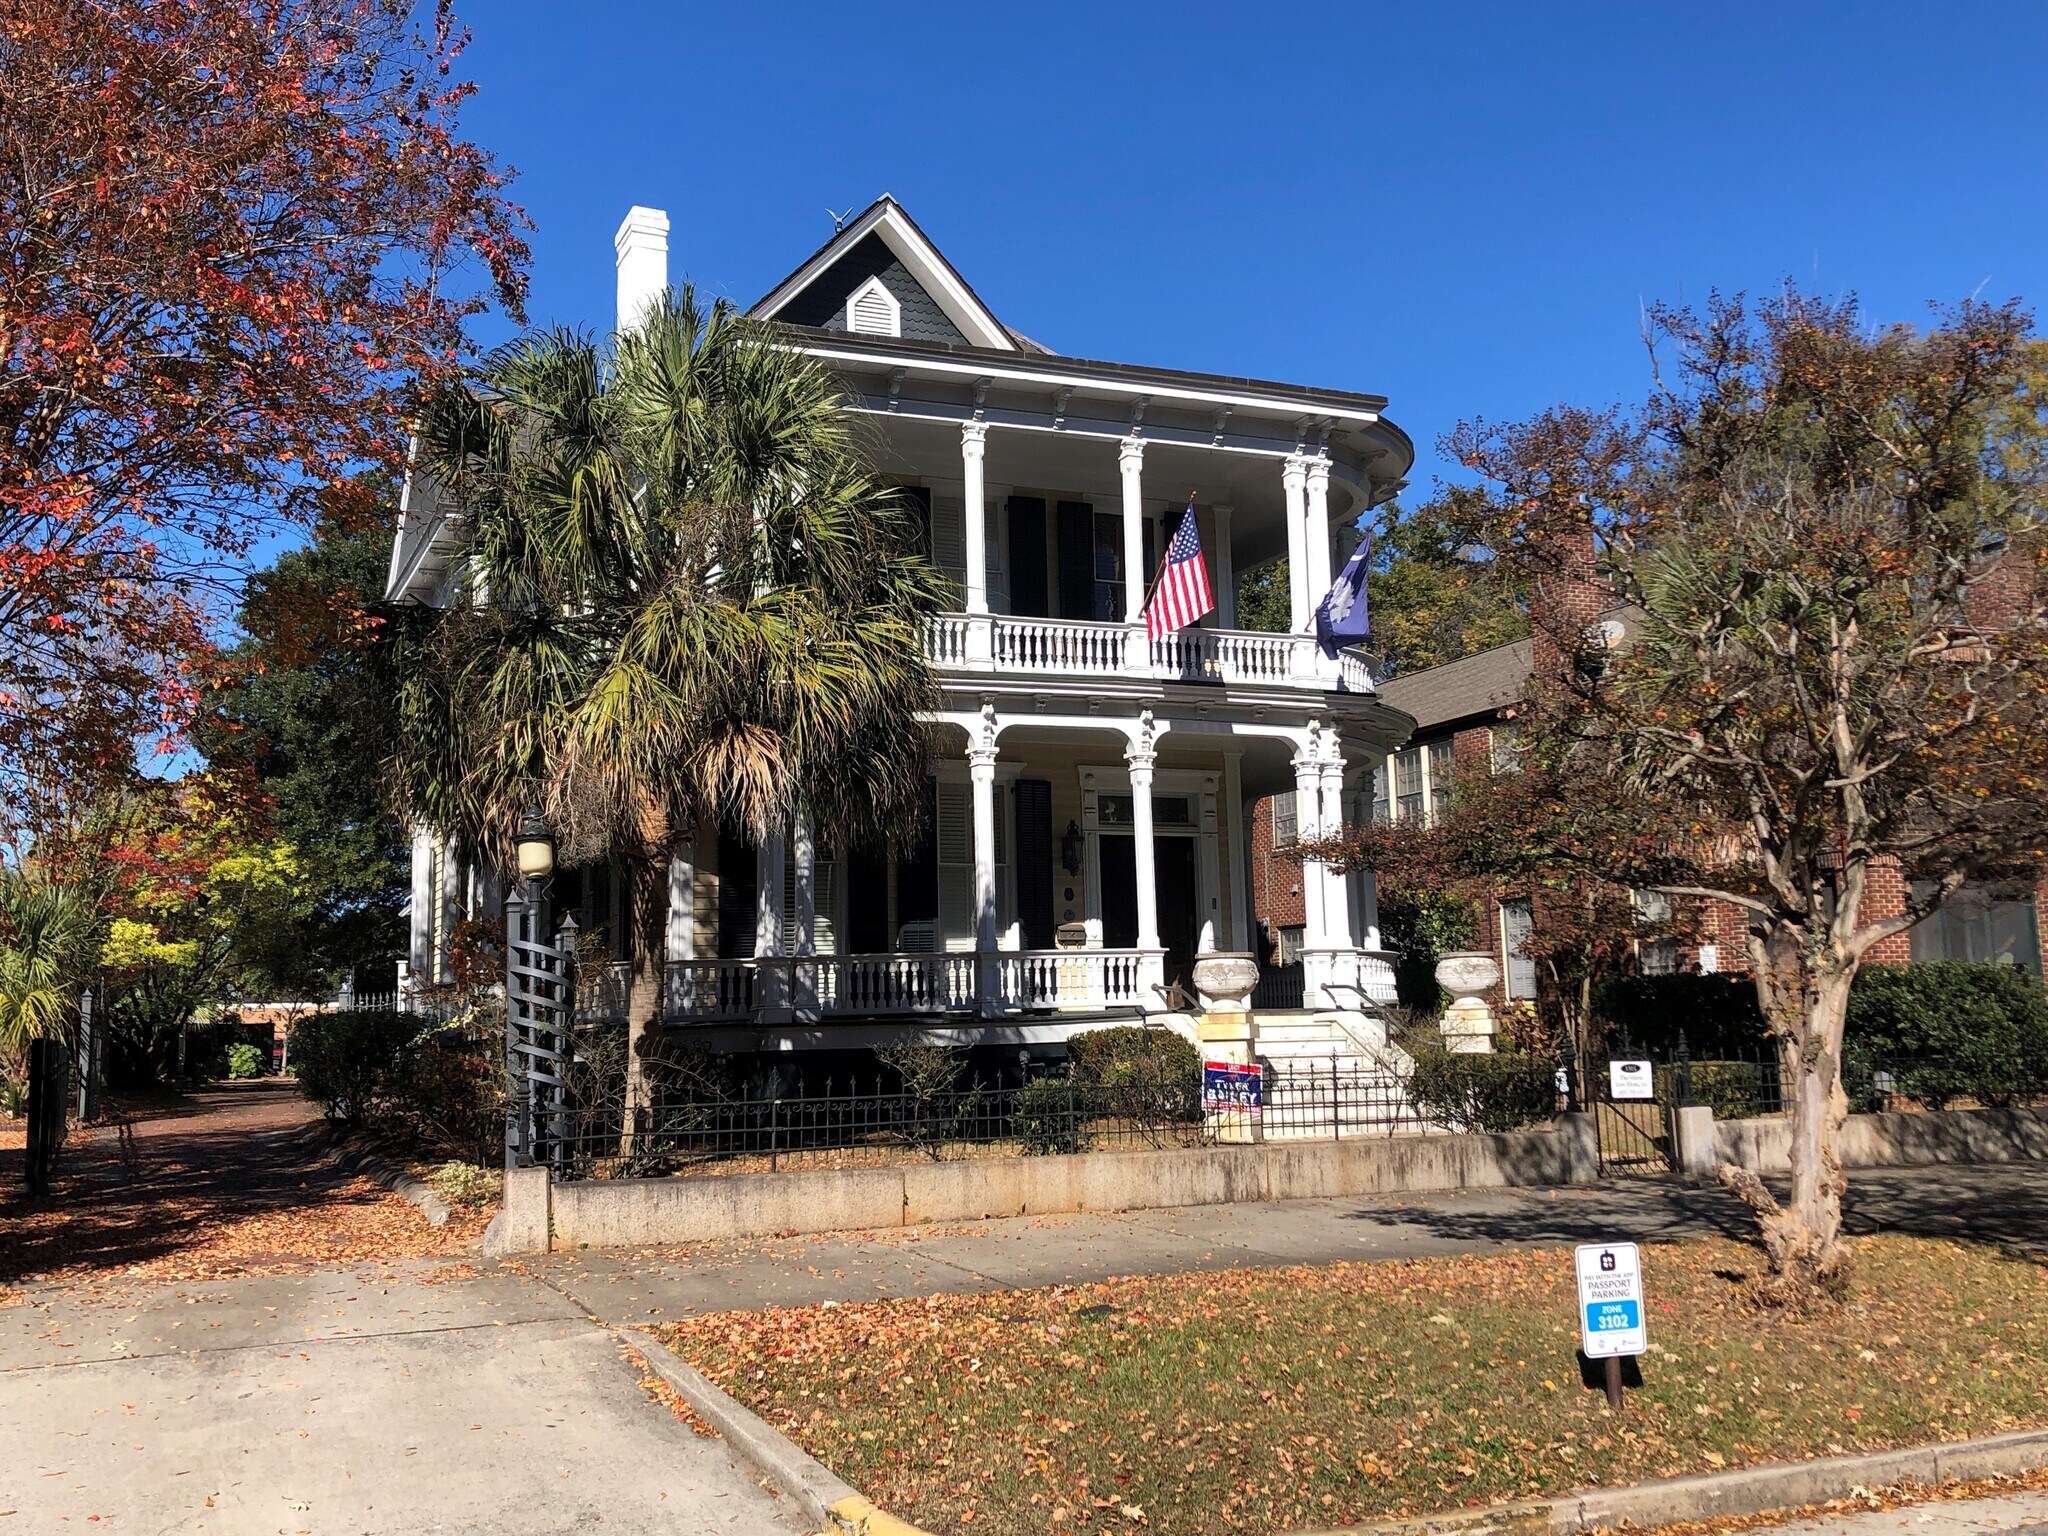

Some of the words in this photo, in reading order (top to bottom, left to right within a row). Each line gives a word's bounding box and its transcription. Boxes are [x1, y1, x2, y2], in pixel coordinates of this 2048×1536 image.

[1588, 1279, 1632, 1290] PASSPORT
[1591, 1289, 1631, 1300] PARKING
[1601, 1304, 1623, 1314] ZONE
[1598, 1313, 1630, 1329] 3102
